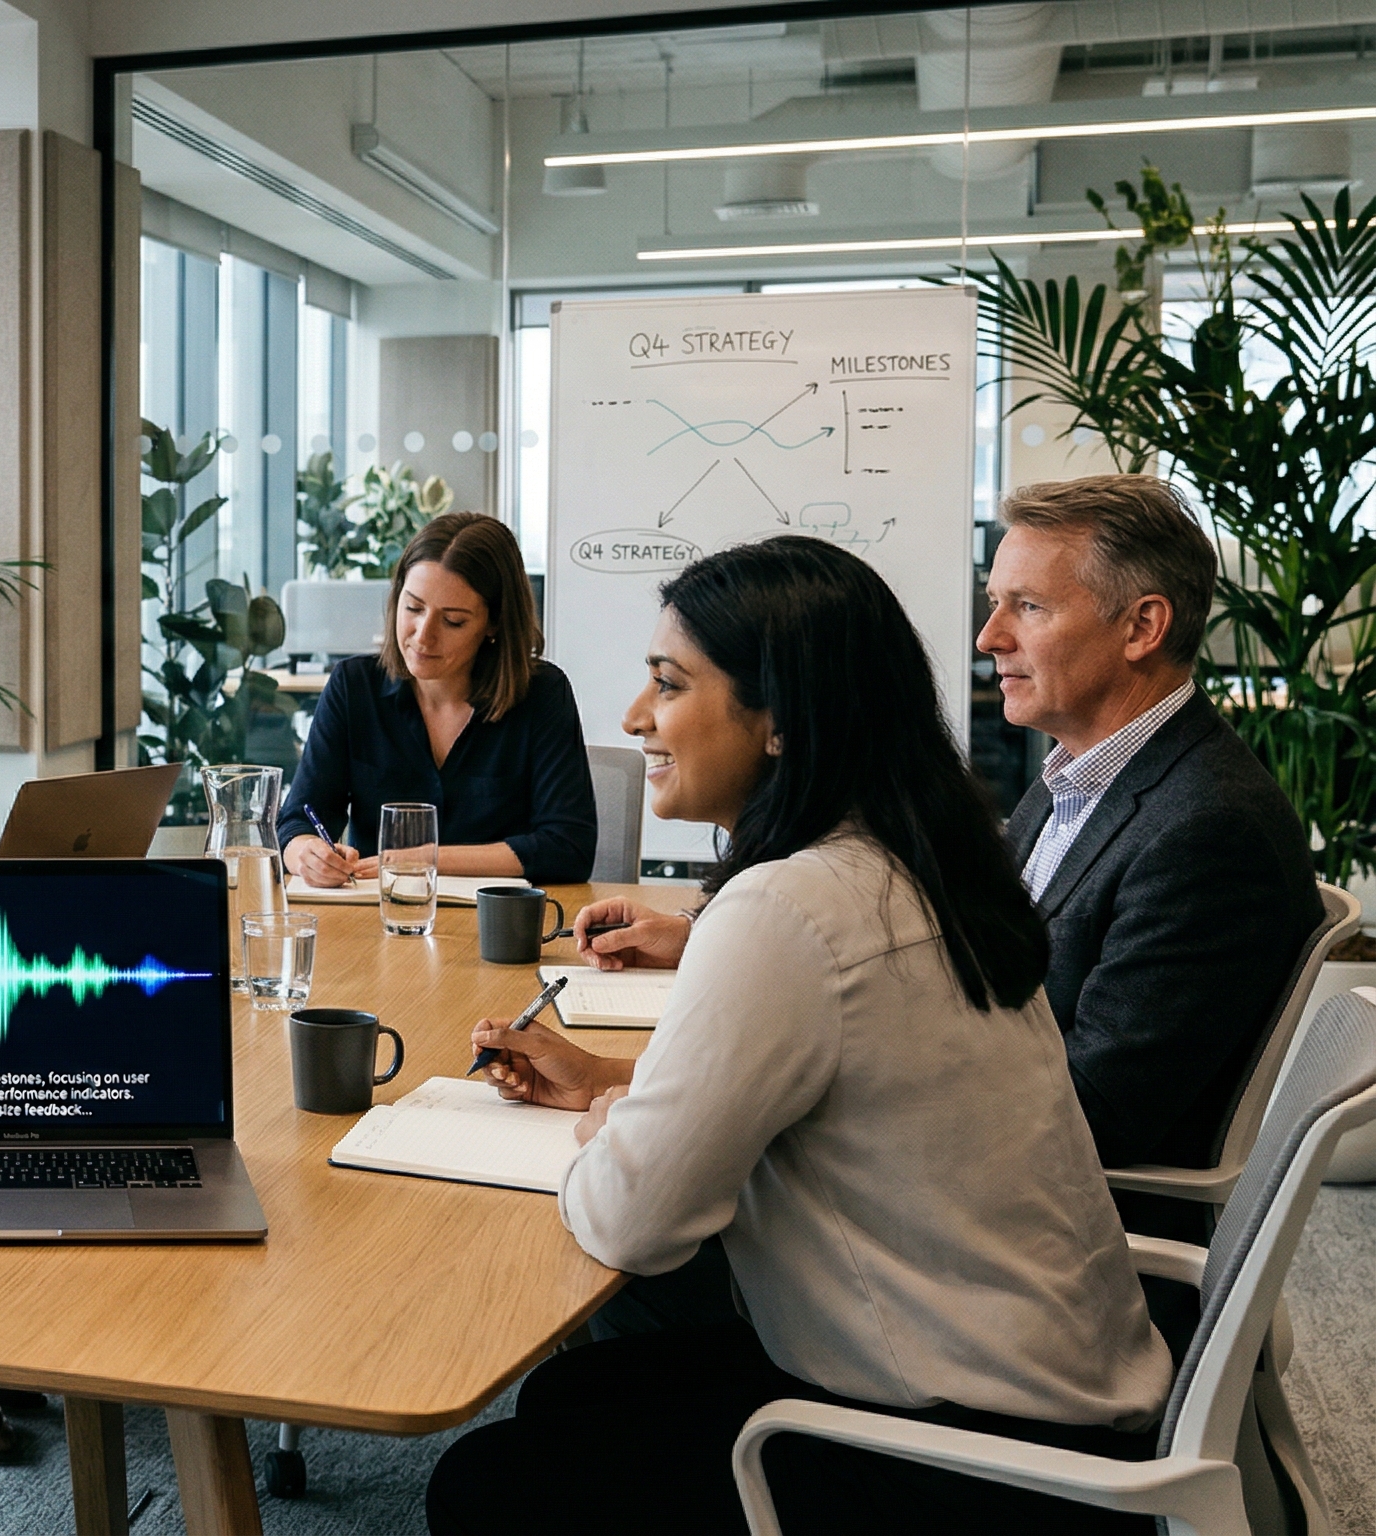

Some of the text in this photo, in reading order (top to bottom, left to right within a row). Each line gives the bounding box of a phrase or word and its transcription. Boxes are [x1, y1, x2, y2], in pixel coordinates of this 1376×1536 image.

[629, 329, 795, 359] Q4 STRATEGY
[831, 353, 951, 375] MILESTONES
[578, 543, 697, 560] Q4 STRATEGY
[48, 1071, 102, 1087] focusing
[103, 1074, 120, 1084] on
[122, 1073, 151, 1084] user
[70, 1087, 135, 1100] indicators.
[24, 1103, 93, 1117] feedback...
